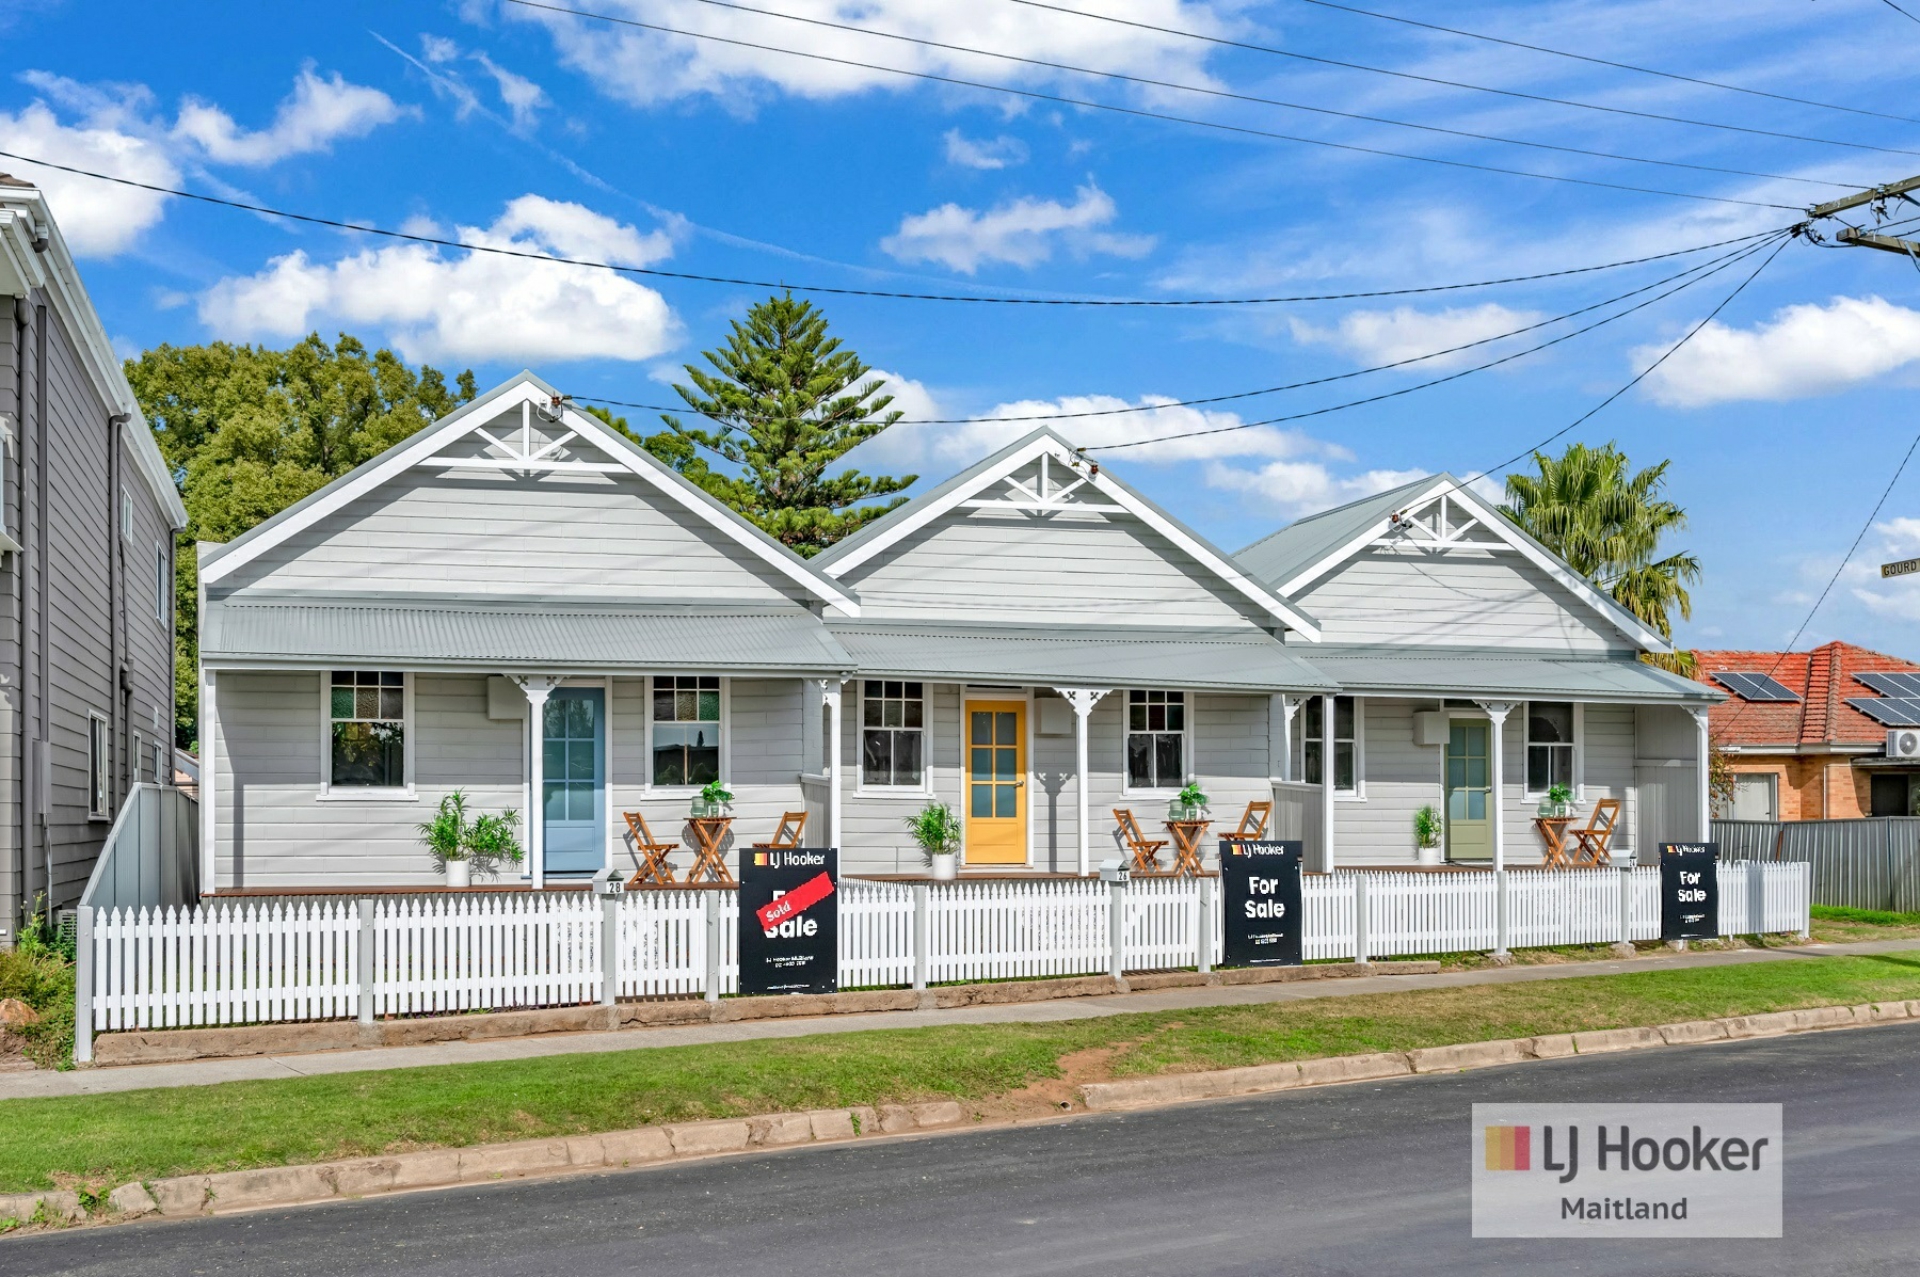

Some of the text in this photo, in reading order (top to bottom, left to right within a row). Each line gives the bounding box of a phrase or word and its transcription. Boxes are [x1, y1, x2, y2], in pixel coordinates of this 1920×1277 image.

[1883, 560, 1917, 576] GOURD
[1242, 843, 1284, 858] LJ Hooker
[769, 851, 825, 869] LJ Hooker
[1118, 871, 1127, 881] 26
[1679, 871, 1701, 885] For
[609, 882, 621, 893] 28
[1248, 876, 1279, 895] For
[1677, 888, 1707, 902] Sale
[765, 900, 792, 922] Sold
[1244, 898, 1285, 918] Sale
